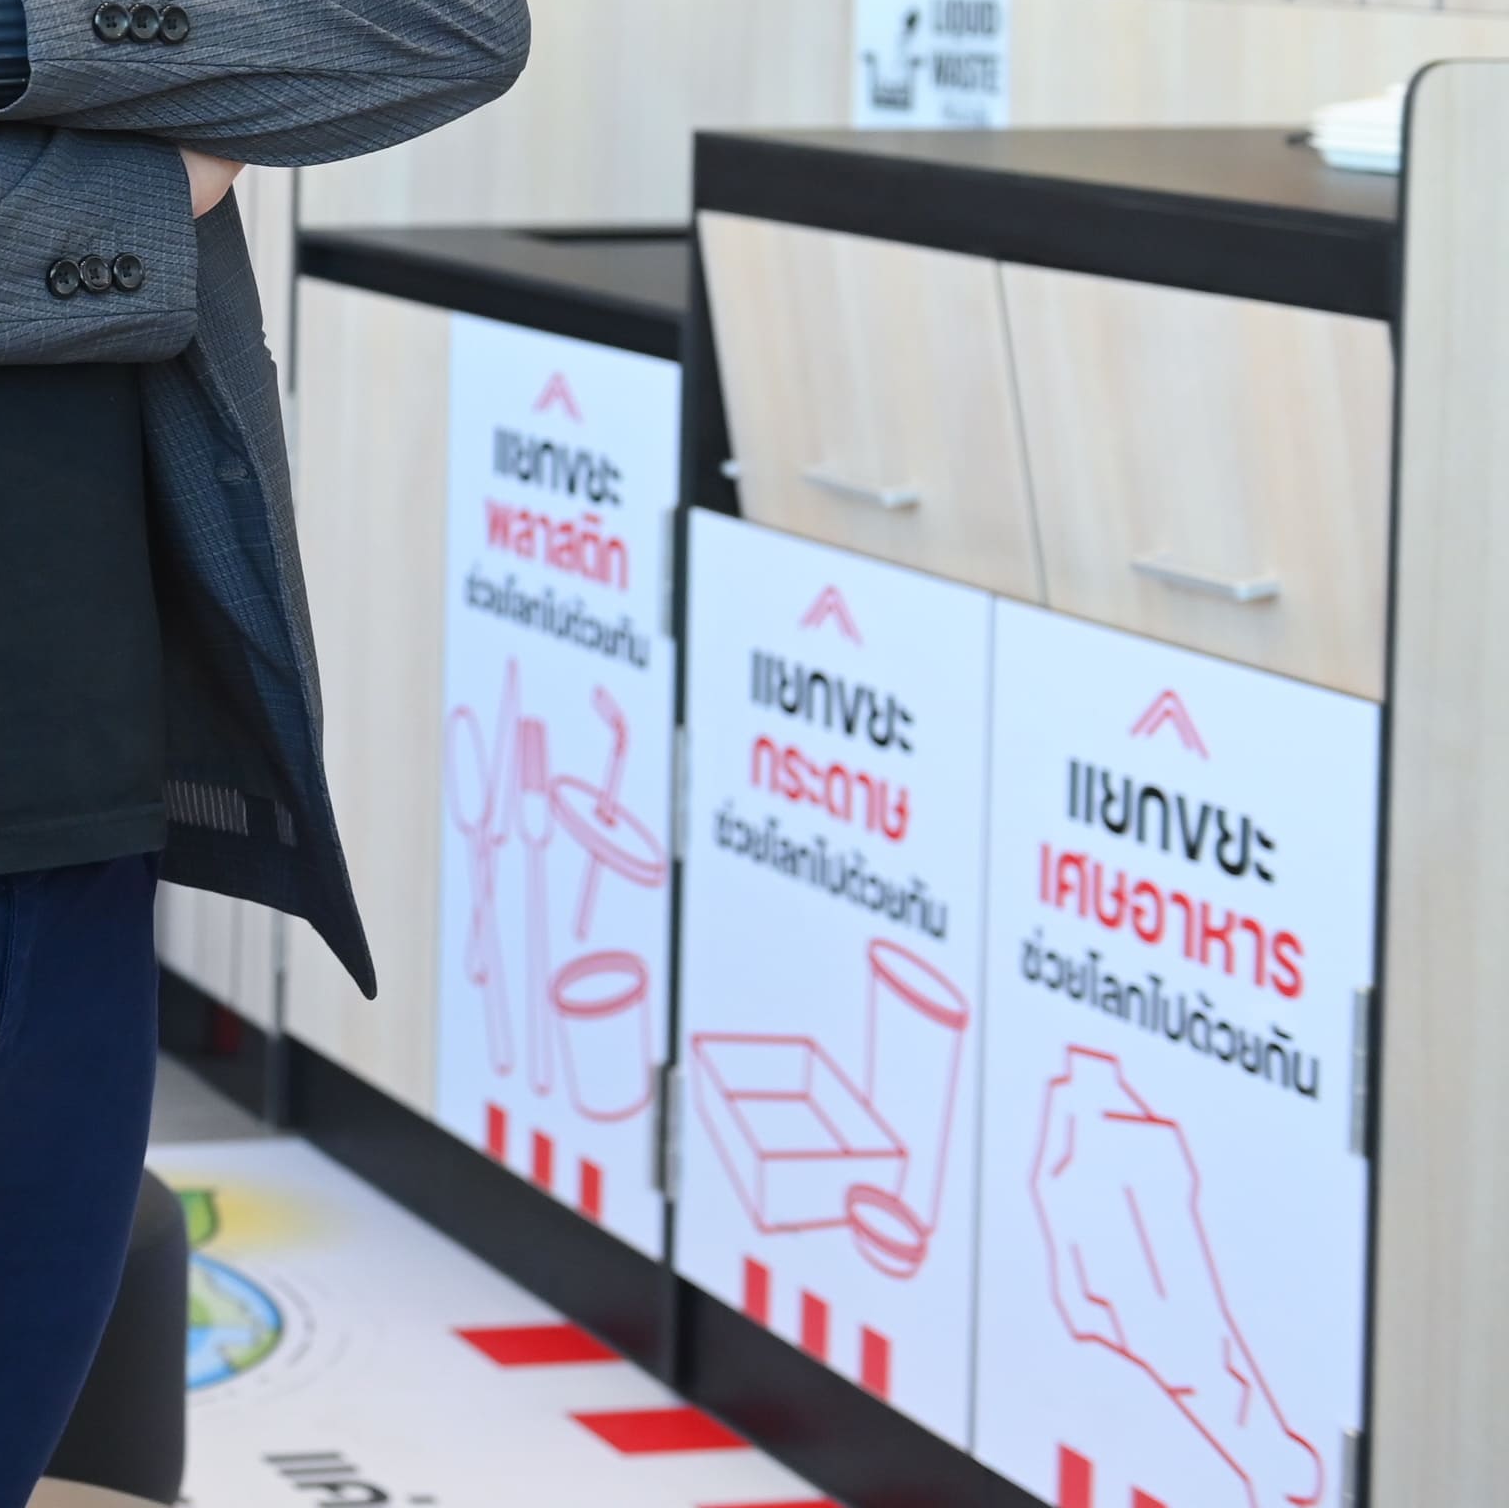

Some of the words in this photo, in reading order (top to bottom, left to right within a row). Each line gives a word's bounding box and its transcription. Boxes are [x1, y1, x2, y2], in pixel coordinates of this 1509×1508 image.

[486, 498, 629, 591] พลาสติก
[751, 649, 913, 754] แยกขยะ
[751, 735, 909, 842] กระดาษ
[1069, 757, 1276, 883] แยกขยะ
[1039, 842, 1304, 1000] เศษอาหาร
[1022, 926, 1319, 1100] ช่วยโลกไปด้วยกัน
